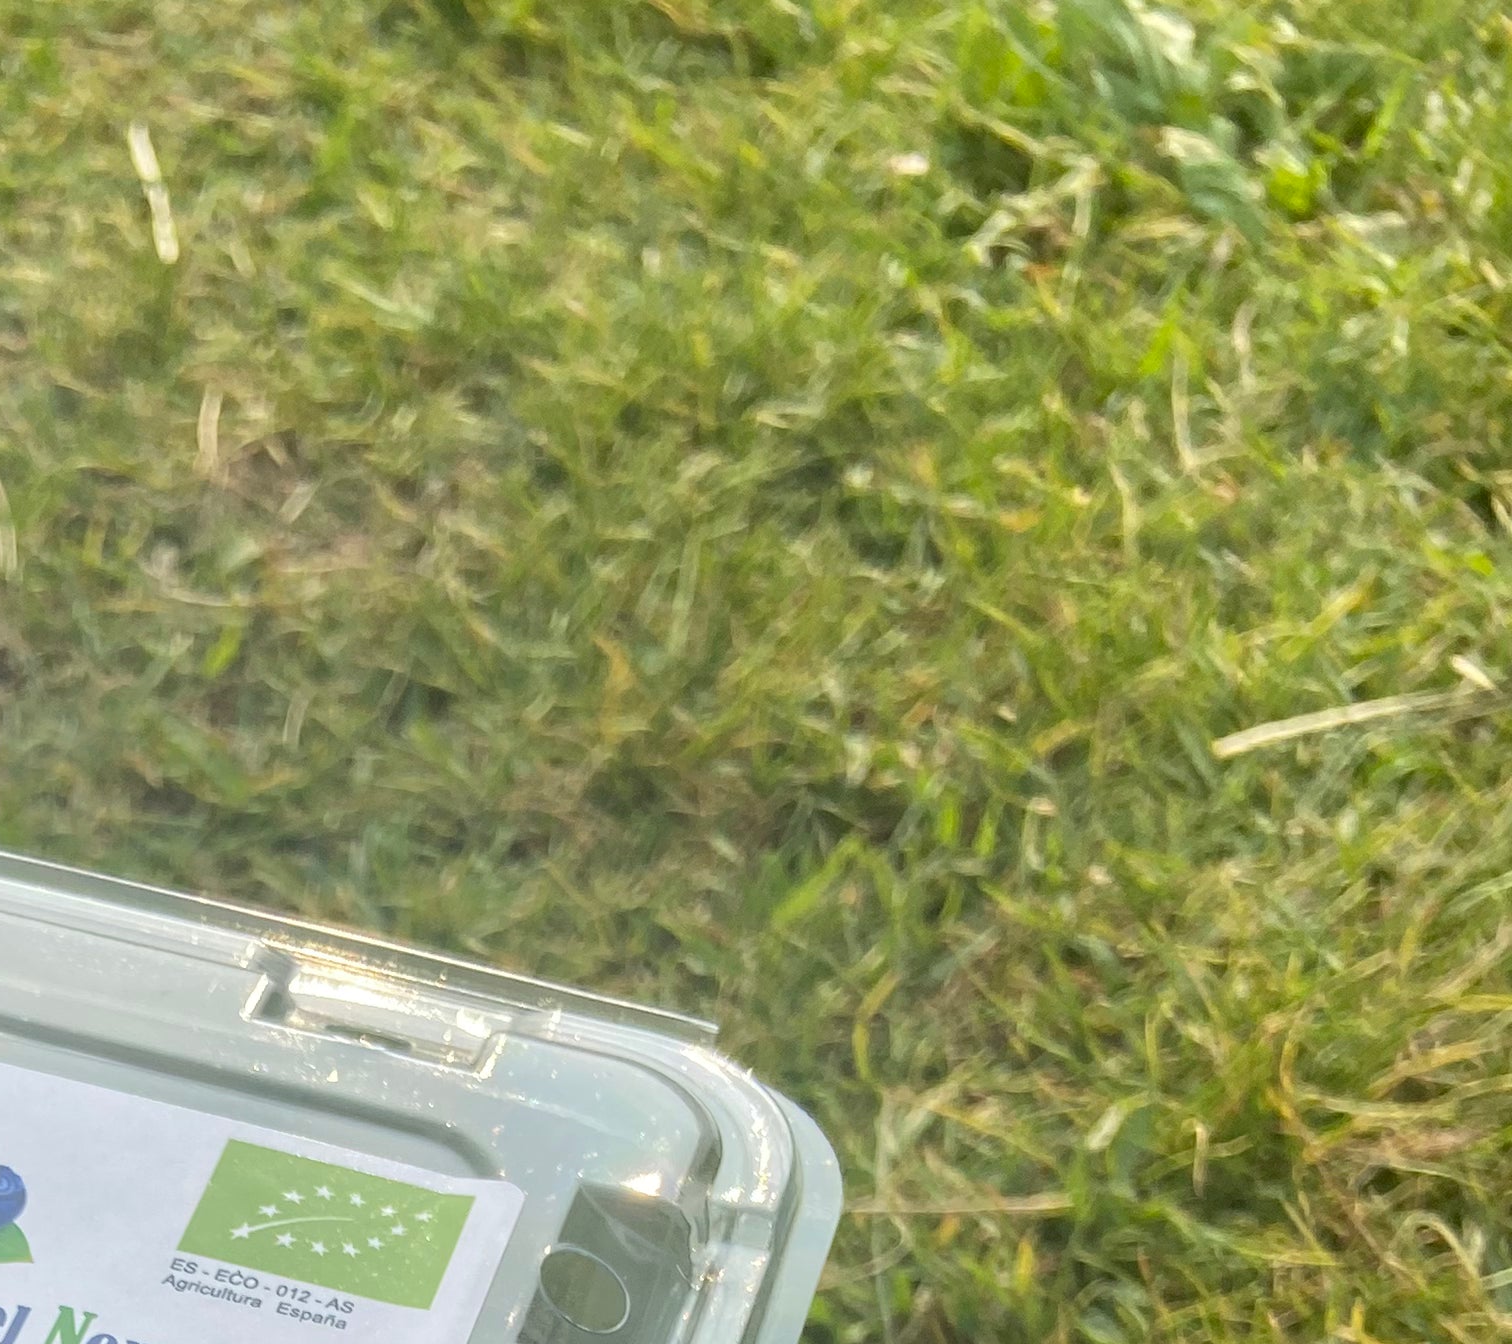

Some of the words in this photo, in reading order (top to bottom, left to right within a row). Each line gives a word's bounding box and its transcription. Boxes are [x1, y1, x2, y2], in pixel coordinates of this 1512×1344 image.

[161, 1273, 263, 1308] Agricultura
[276, 1301, 348, 1330] España
[170, 1257, 198, 1275] ES
[276, 1284, 311, 1304] 012
[325, 1296, 355, 1314] AS
